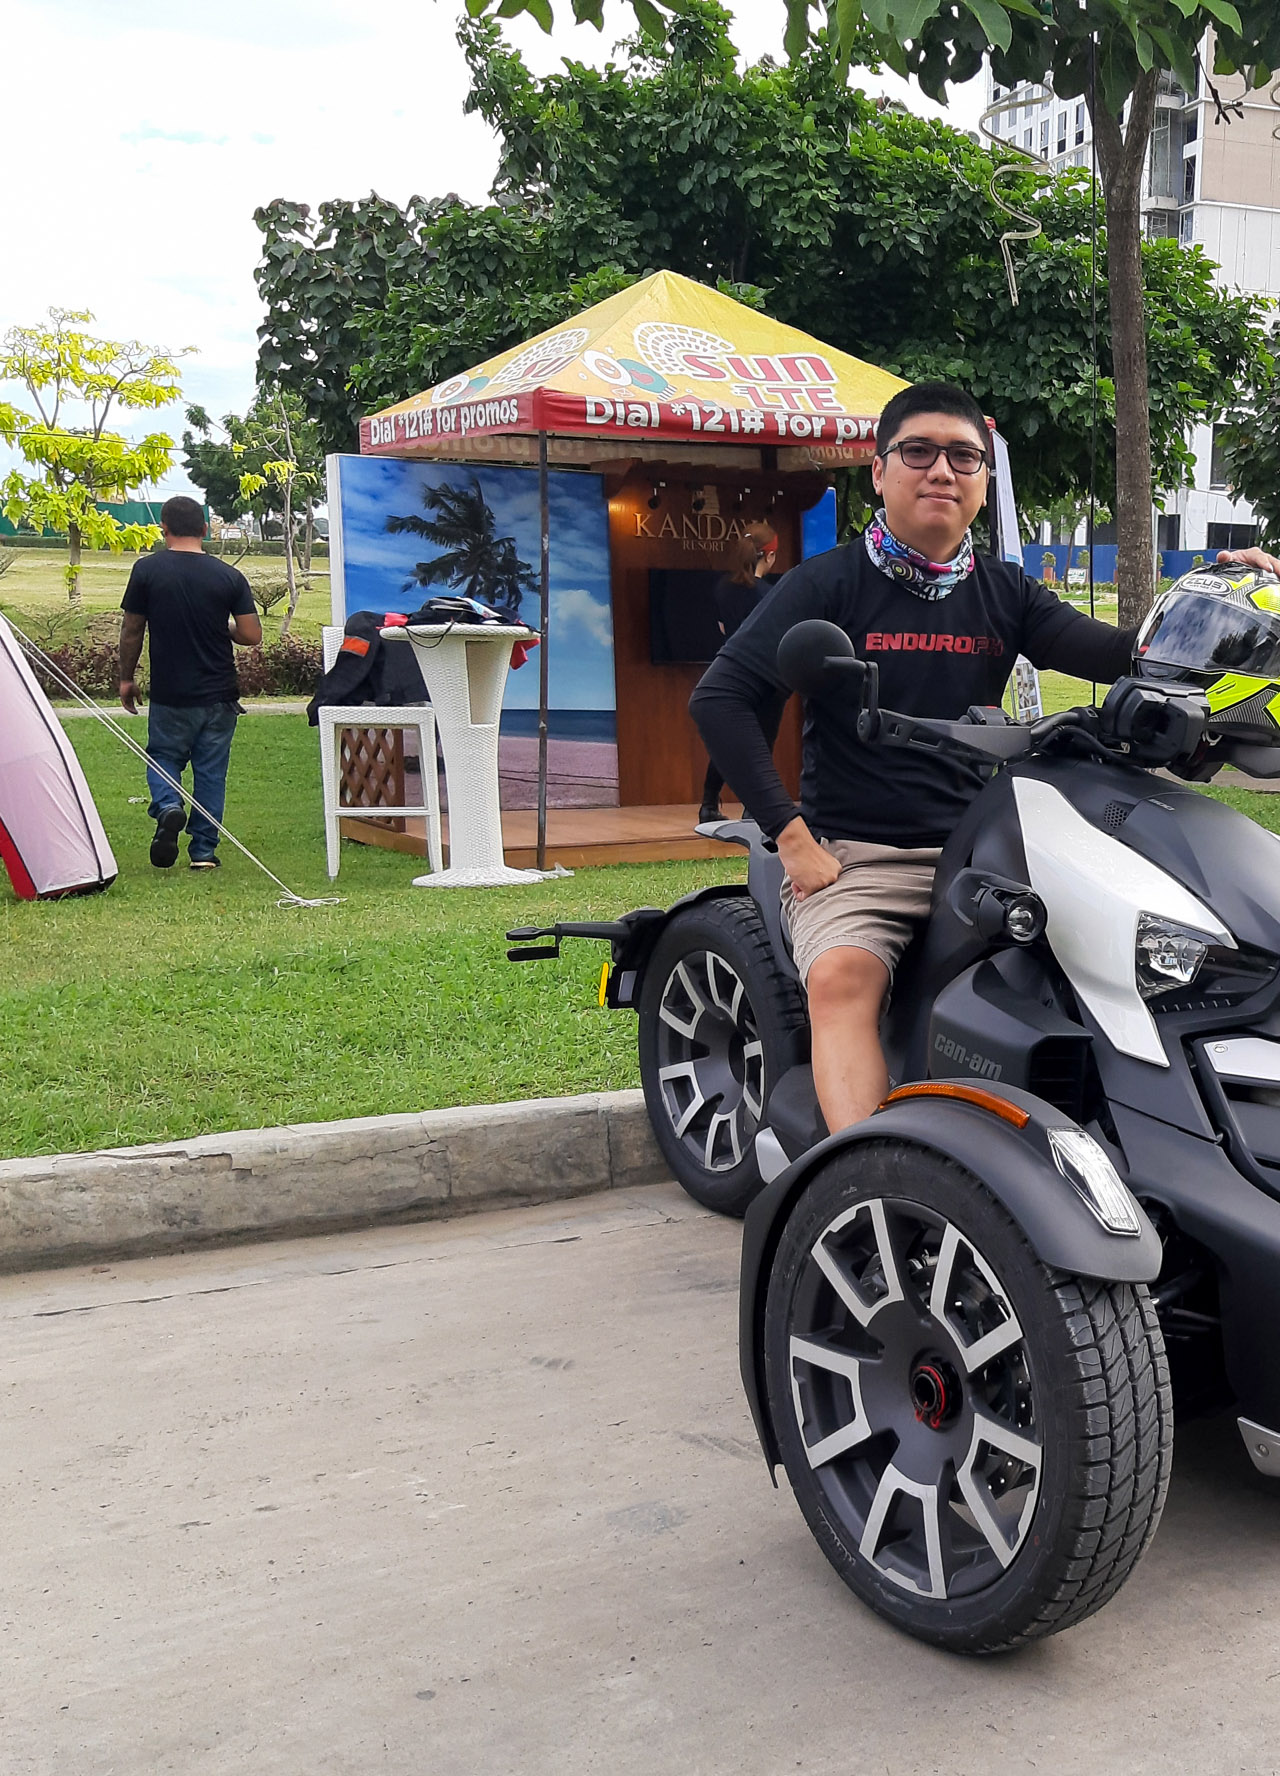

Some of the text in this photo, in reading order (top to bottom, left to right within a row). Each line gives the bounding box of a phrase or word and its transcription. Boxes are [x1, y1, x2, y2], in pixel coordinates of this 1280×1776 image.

[746, 385, 845, 412] LTE
[370, 414, 395, 445] Dial
[436, 407, 457, 433] for
[460, 399, 518, 436] promos
[585, 395, 660, 428] Dial
[774, 411, 826, 438] for
[633, 512, 769, 541] KANDA
[683, 540, 726, 552] RESORT
[1186, 577, 1224, 590] ZEUS
[934, 1033, 1003, 1081] can-am
